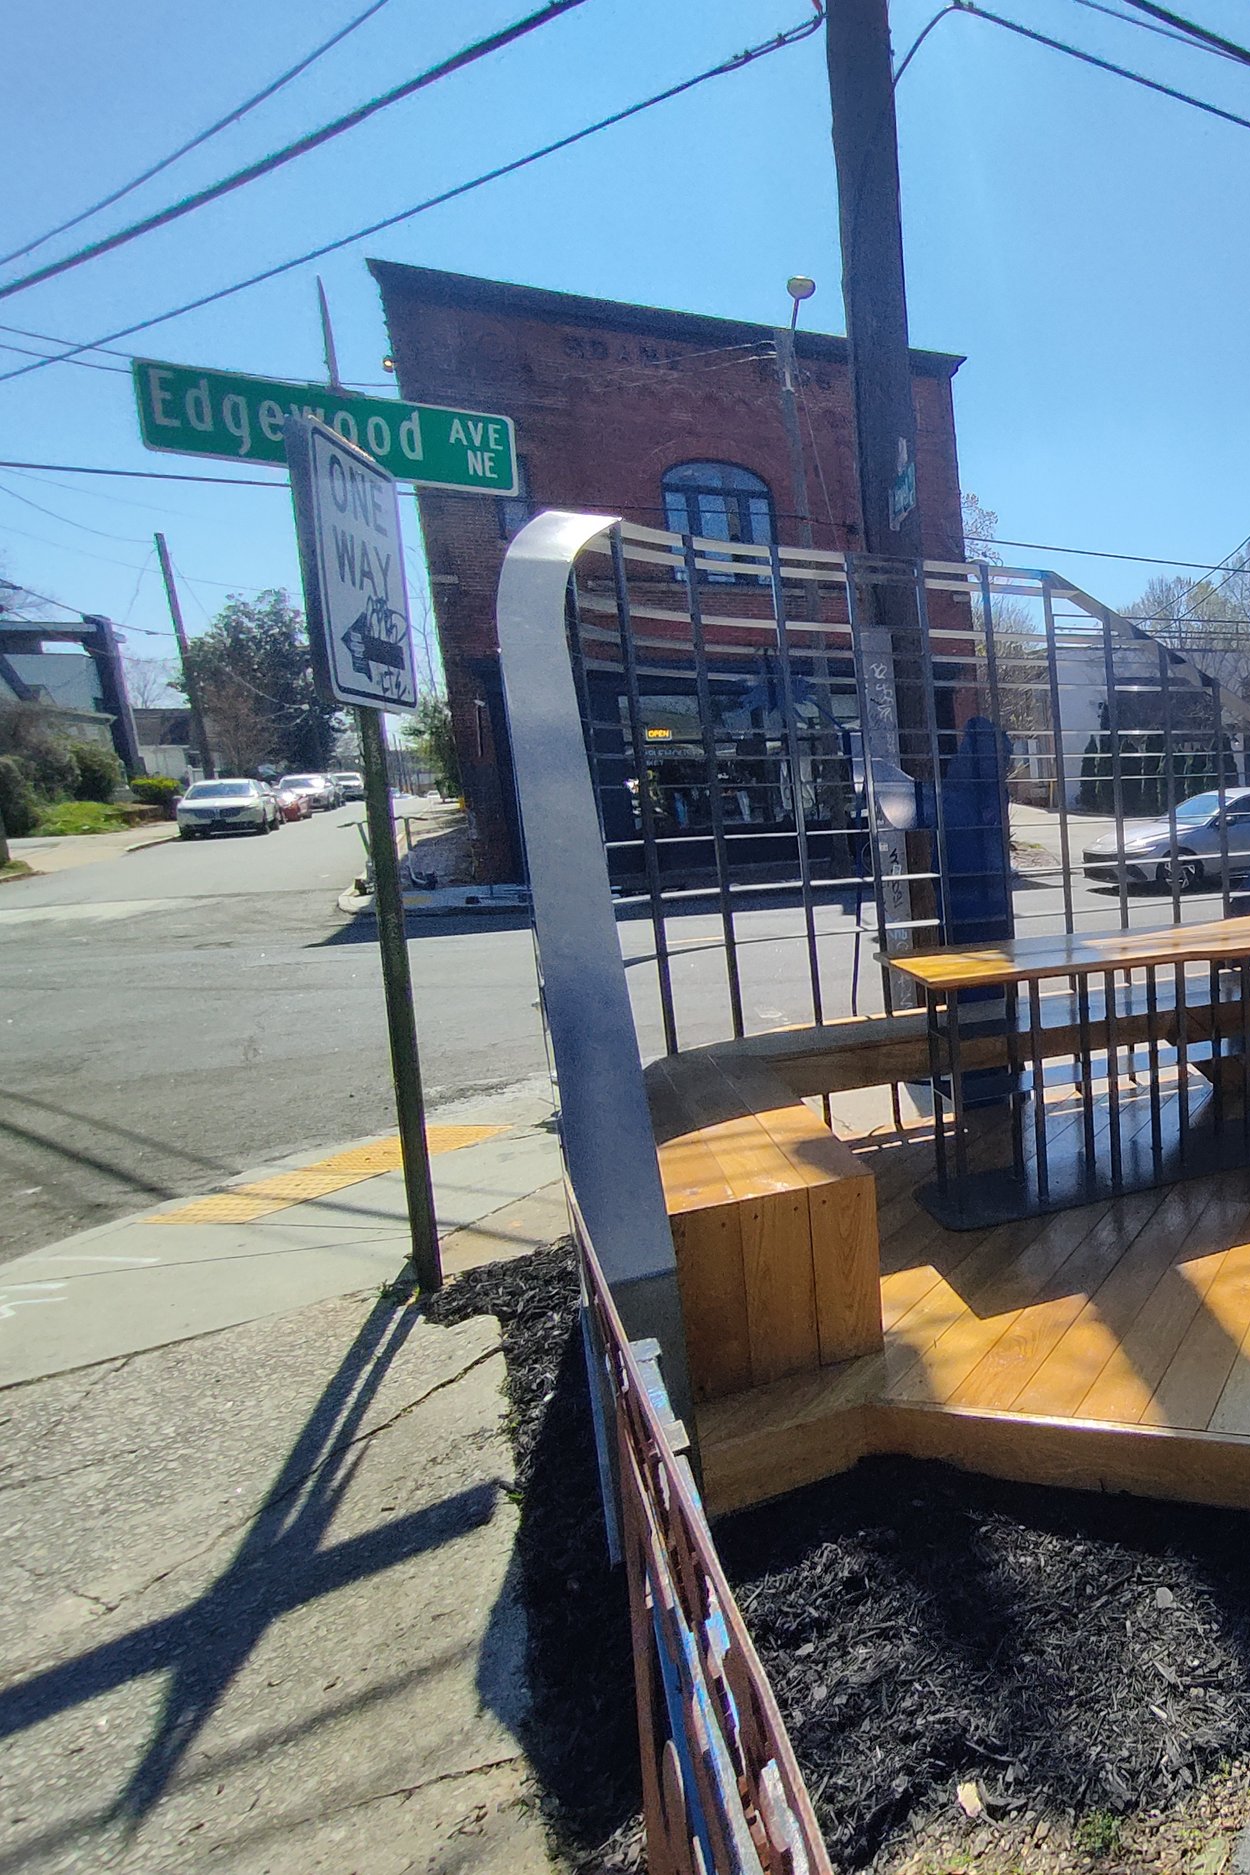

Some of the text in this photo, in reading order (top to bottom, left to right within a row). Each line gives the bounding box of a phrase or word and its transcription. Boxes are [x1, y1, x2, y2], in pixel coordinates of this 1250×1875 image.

[449, 418, 503, 450] AVE
[467, 449, 498, 479] NE
[329, 454, 388, 537] ONE
[332, 524, 391, 601] WAY
[648, 728, 670, 738] OPEN
